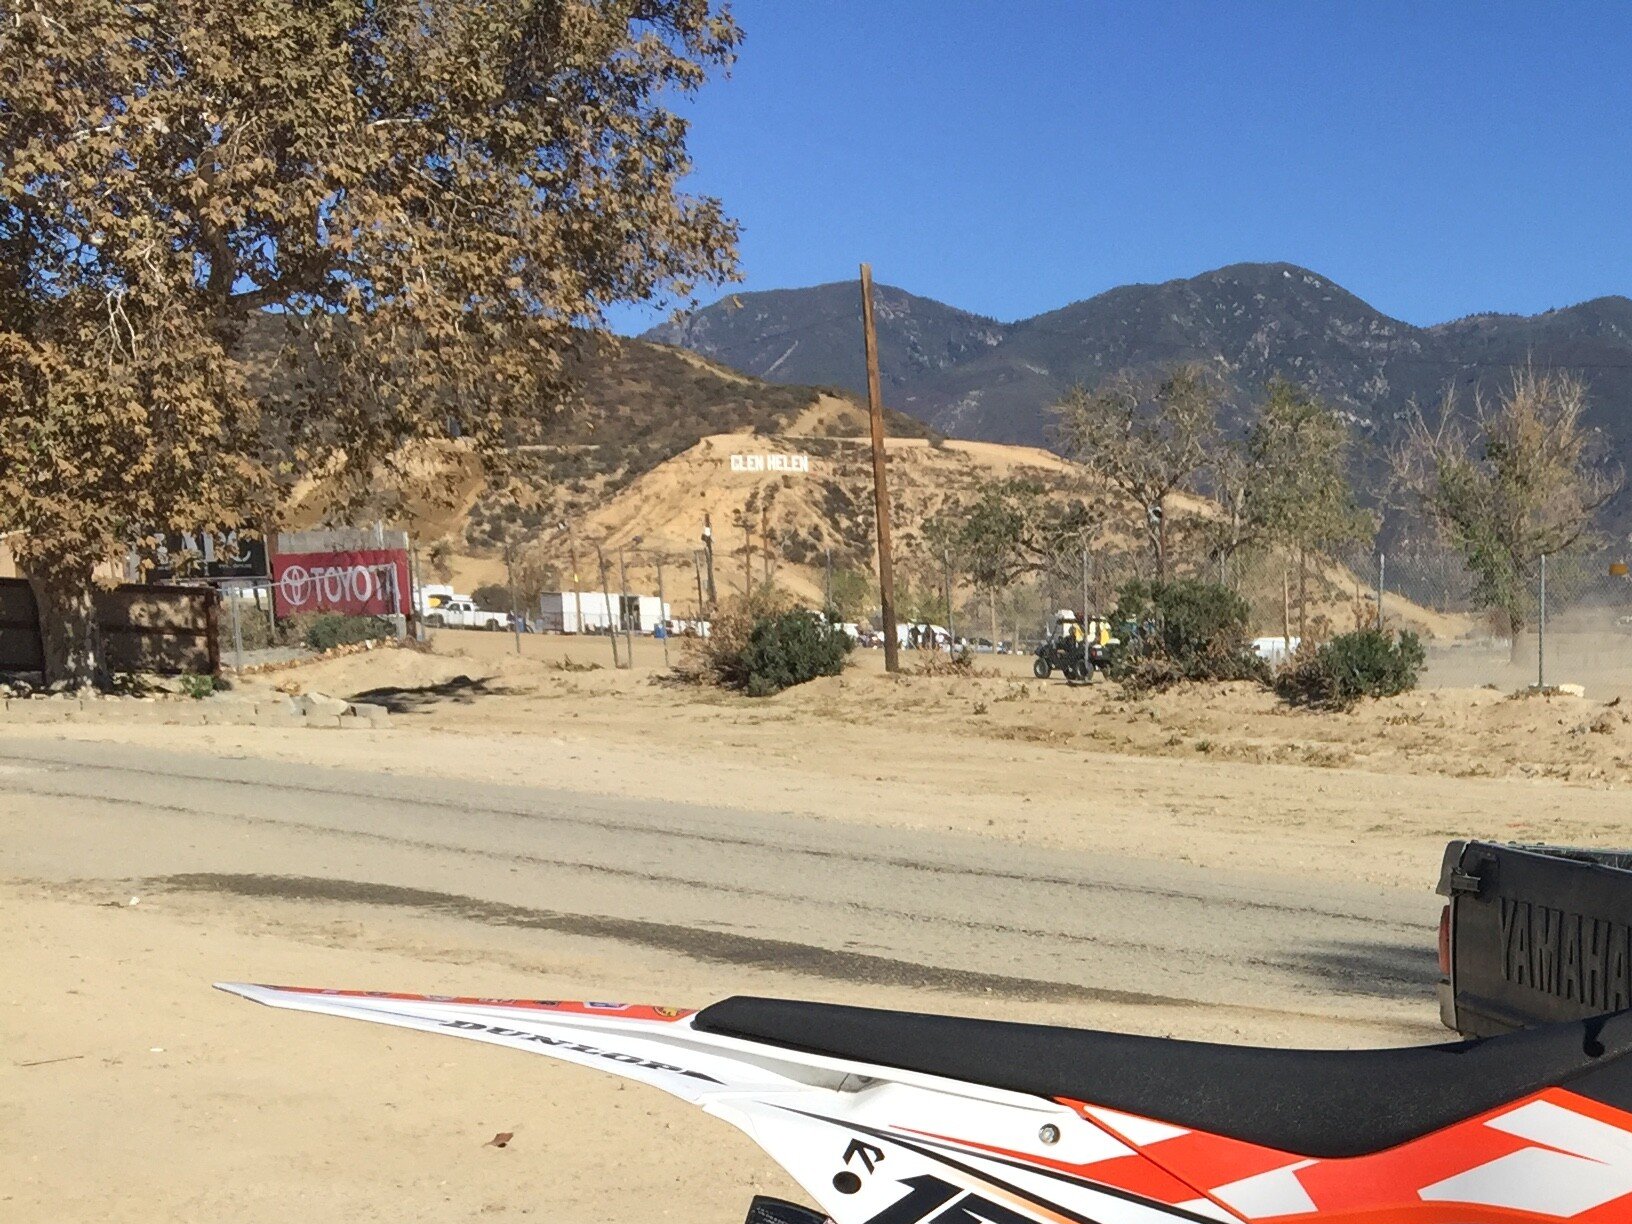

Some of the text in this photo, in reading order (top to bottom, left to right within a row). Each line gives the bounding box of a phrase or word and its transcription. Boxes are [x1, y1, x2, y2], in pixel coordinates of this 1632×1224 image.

[730, 454, 809, 472] GLEN HELEN
[311, 564, 401, 604] TOYOT
[1499, 895, 1632, 1012] YAMAHA
[439, 1019, 684, 1071] DUNLOP
